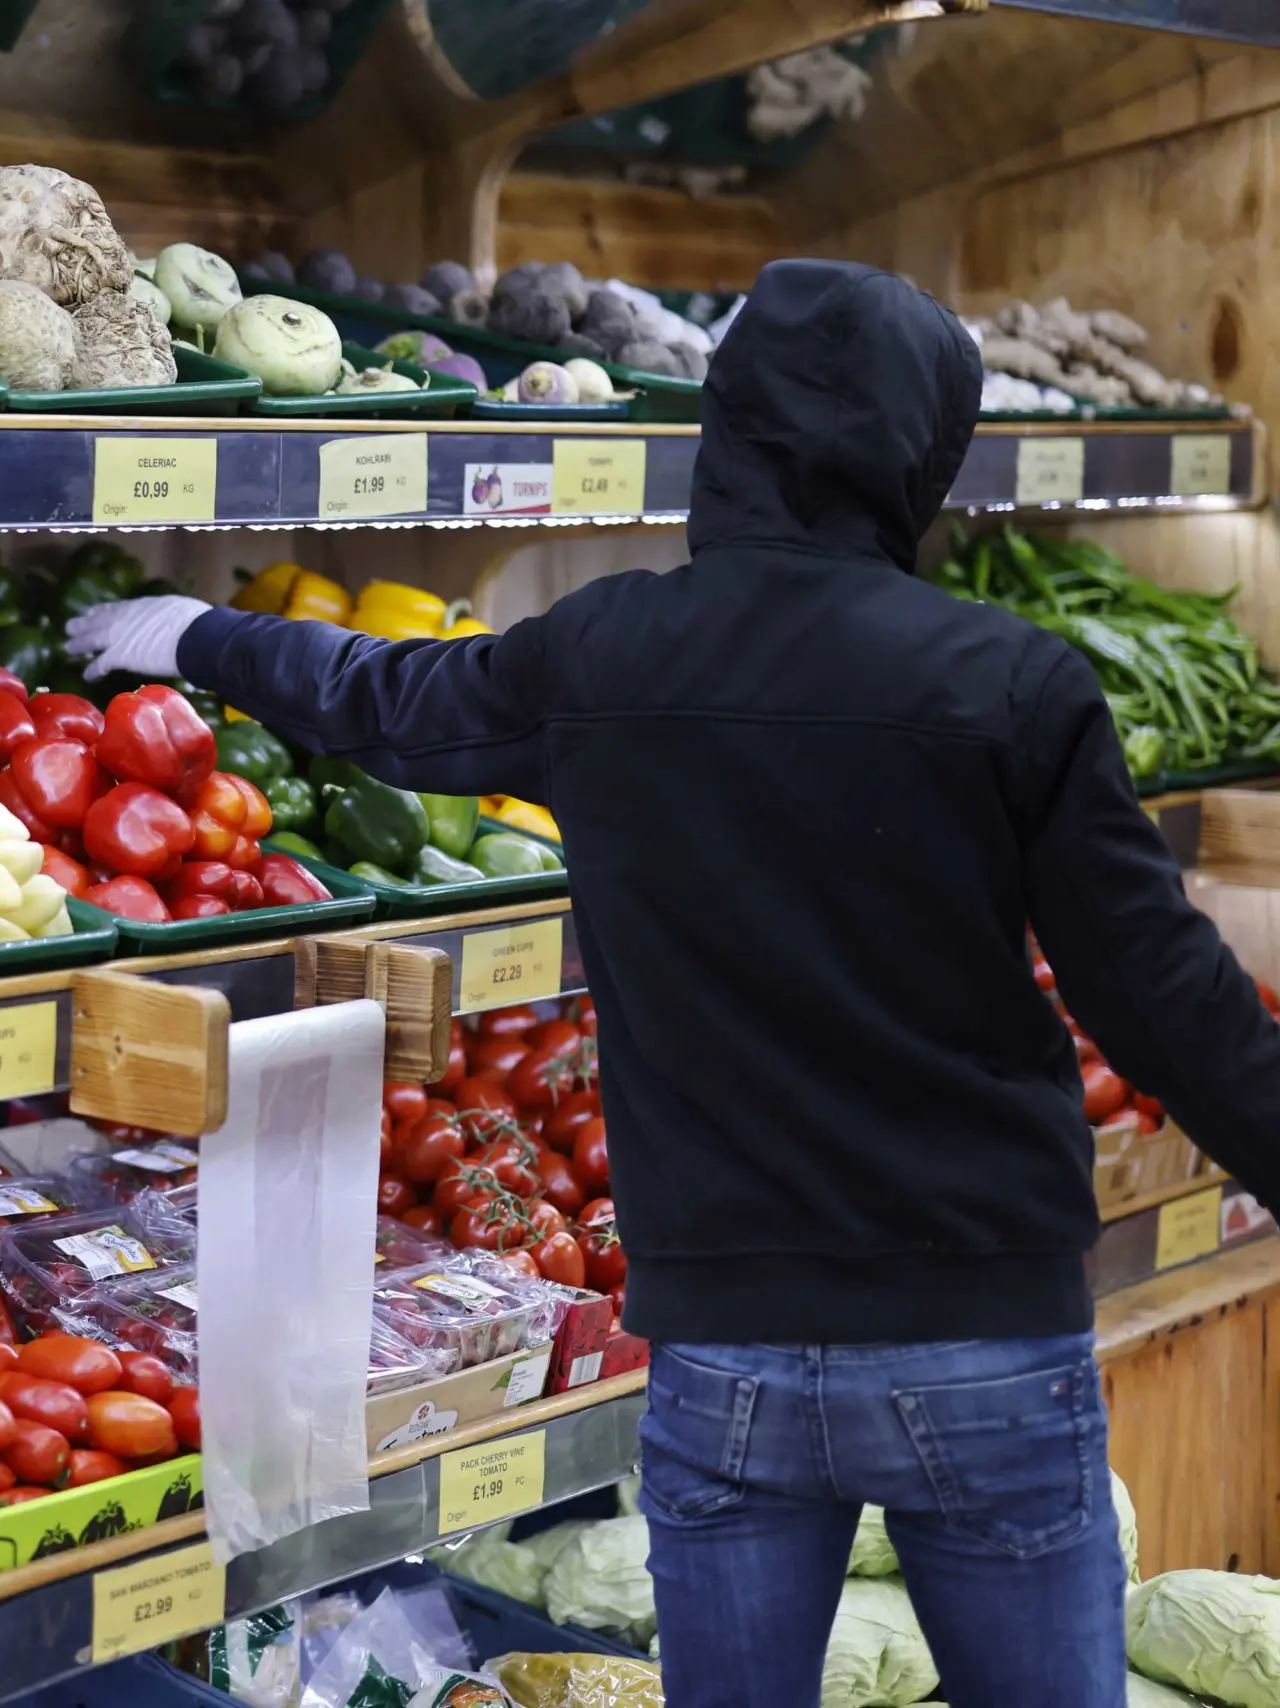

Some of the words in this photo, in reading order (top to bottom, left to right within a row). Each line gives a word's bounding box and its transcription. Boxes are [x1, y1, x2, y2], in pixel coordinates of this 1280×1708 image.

[138, 458, 177, 468] CELERIAC
[355, 454, 392, 465] KOHLRABI
[183, 483, 195, 494] KG
[512, 482, 548, 497] TURNIPS
[492, 965, 522, 984] £2.29
[460, 1459, 479, 1470] PACK
[480, 1450, 508, 1465] CHERRY
[509, 1446, 525, 1457] VINE
[479, 1462, 508, 1477] TOMATO
[133, 1595, 173, 1622] £2.99
